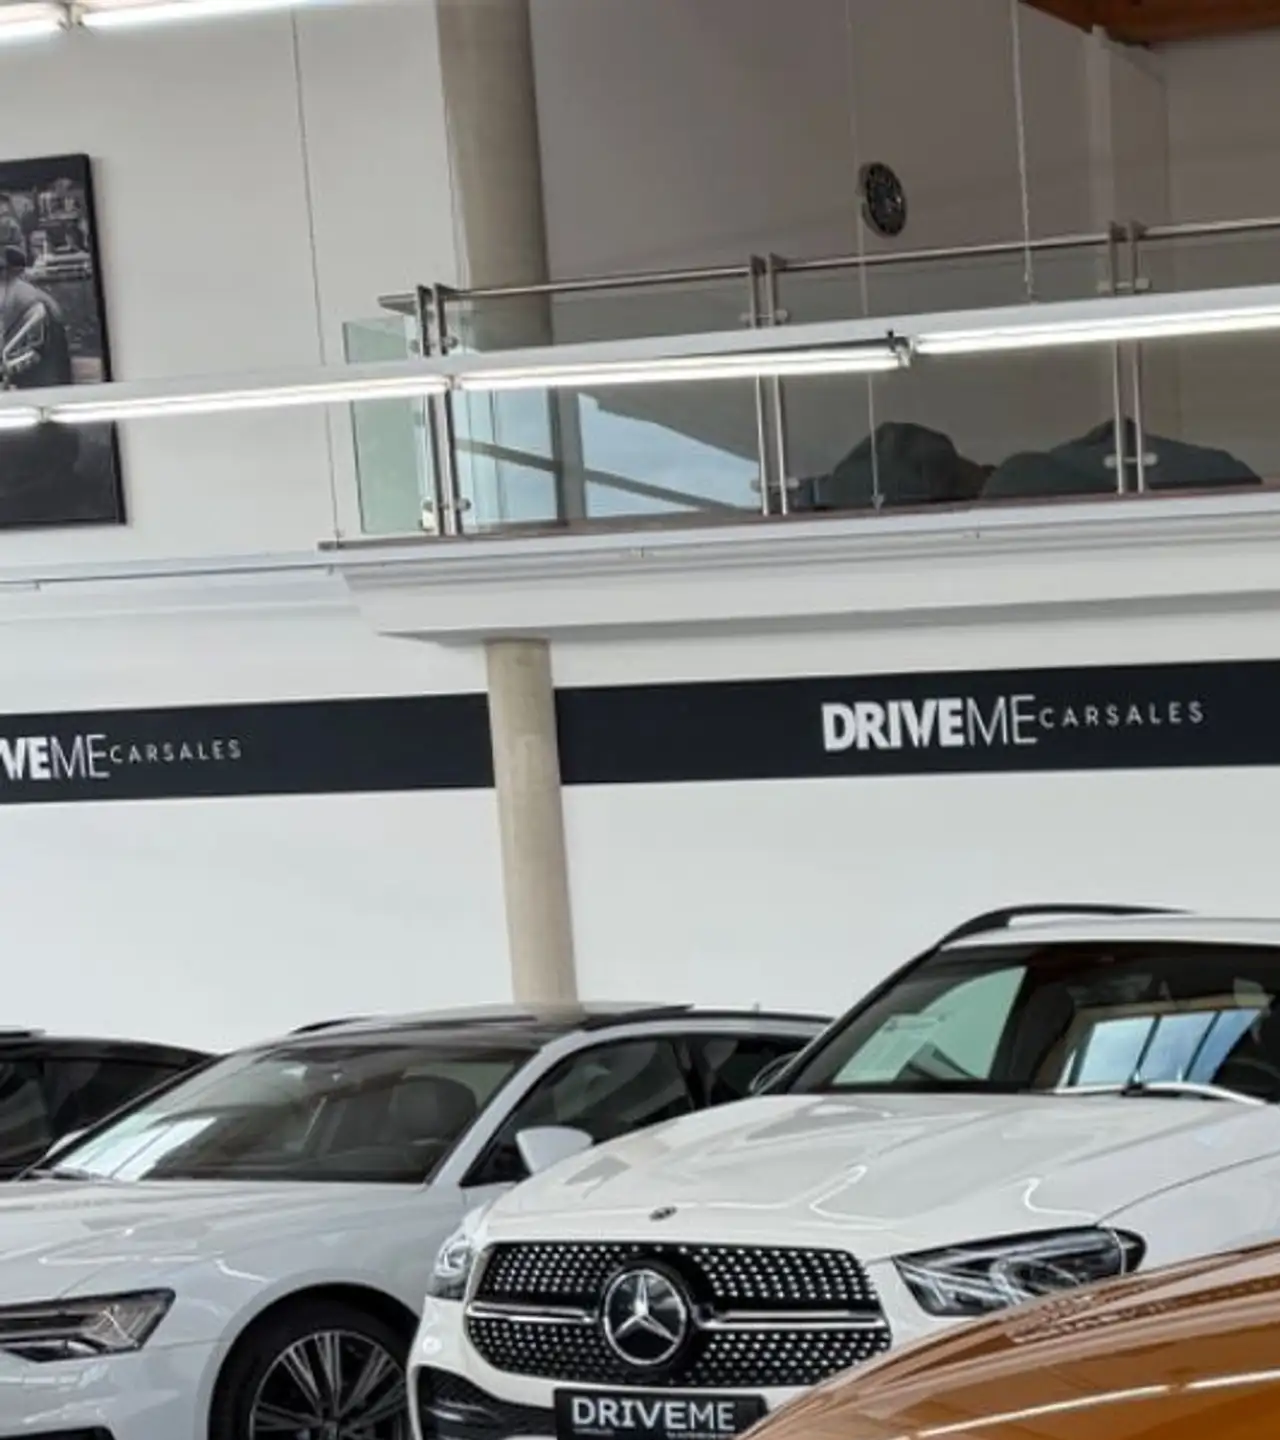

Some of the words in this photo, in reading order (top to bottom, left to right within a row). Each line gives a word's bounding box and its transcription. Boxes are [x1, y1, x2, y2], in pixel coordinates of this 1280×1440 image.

[821, 693, 1038, 751] DRIVEME
[1039, 702, 1204, 730] CARSALES
[110, 739, 242, 764] CARSALES
[571, 1396, 736, 1432] DRIVEME
